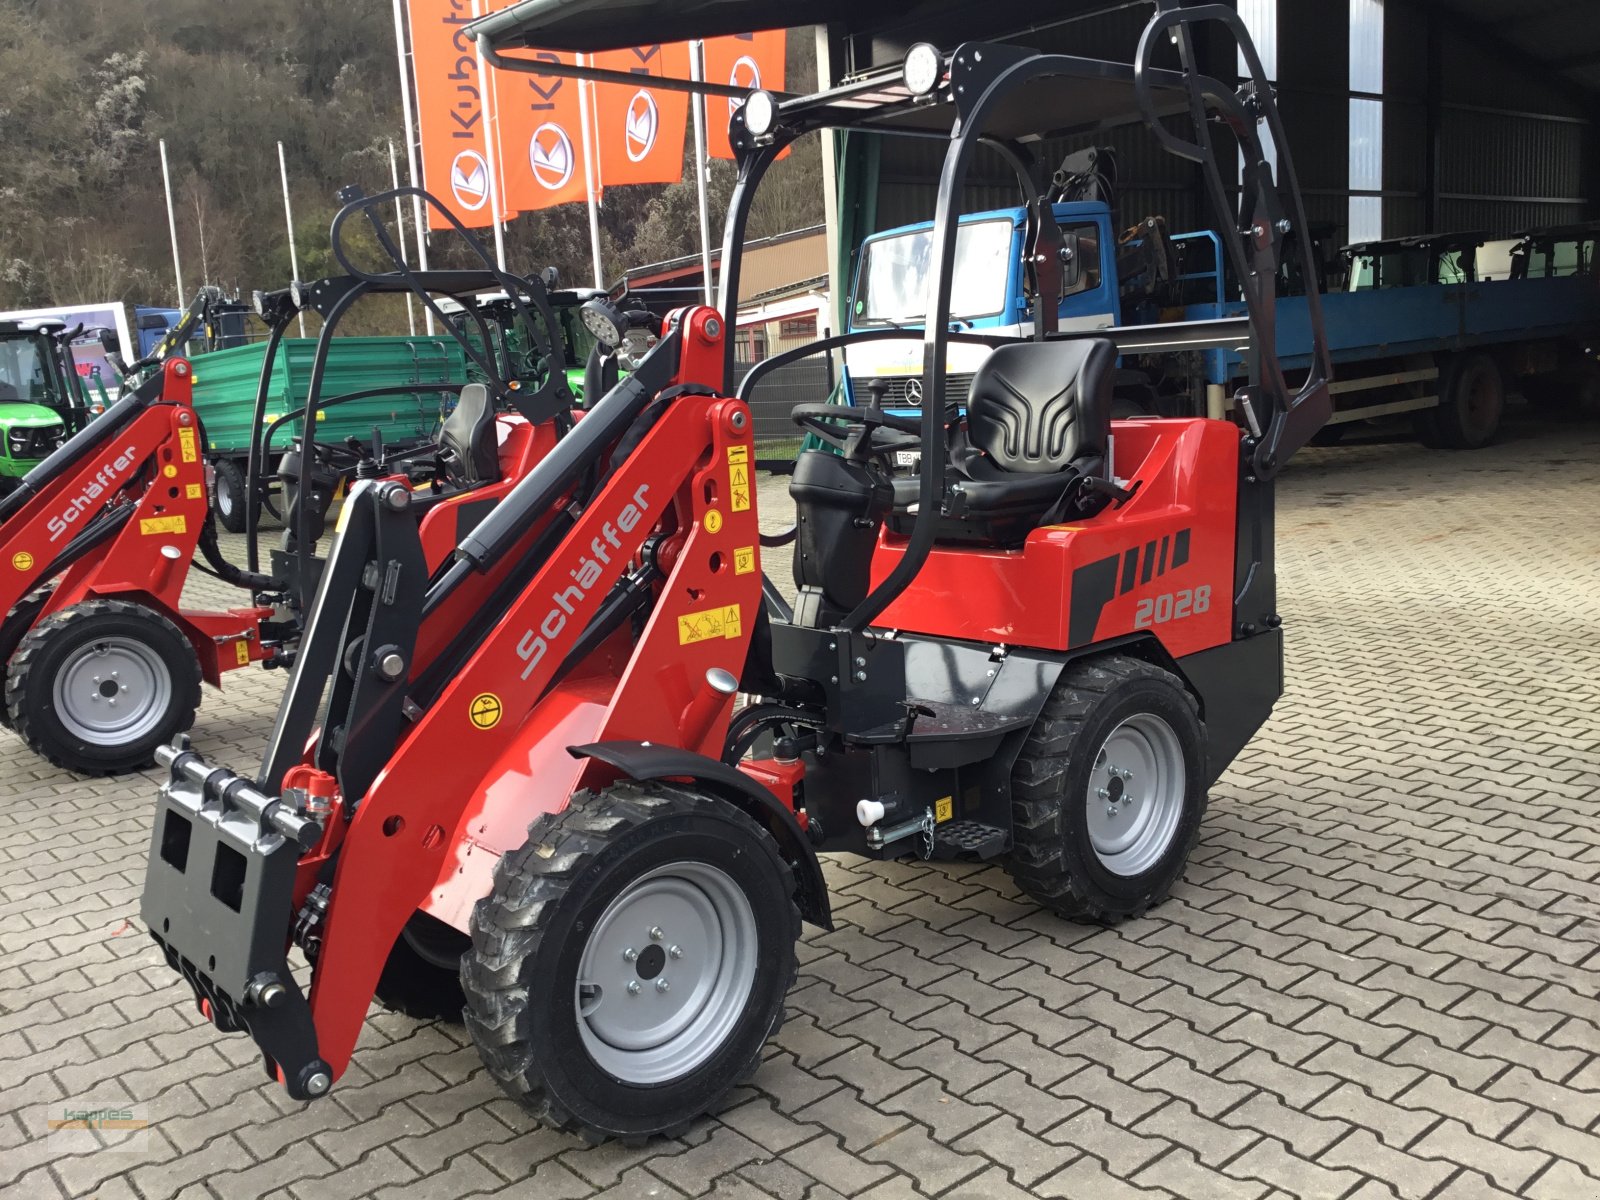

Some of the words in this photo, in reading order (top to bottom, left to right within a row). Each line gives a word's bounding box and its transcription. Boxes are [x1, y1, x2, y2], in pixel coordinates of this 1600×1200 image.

[47, 446, 136, 542] Schäffer
[516, 483, 650, 681] Schäffer
[1134, 584, 1211, 629] 2028
